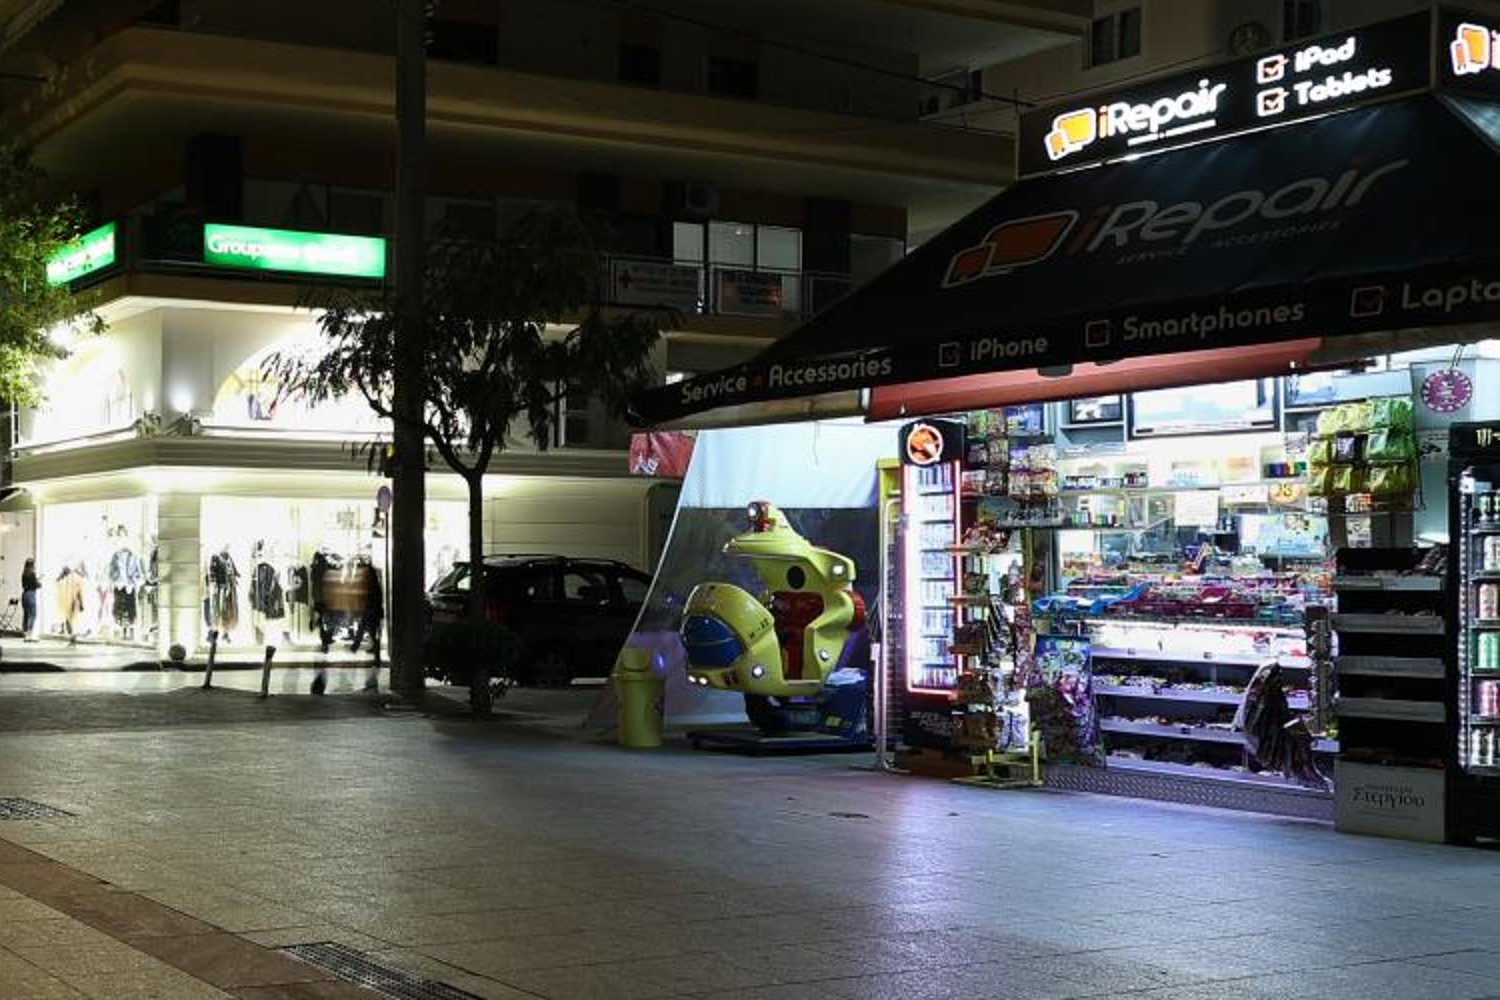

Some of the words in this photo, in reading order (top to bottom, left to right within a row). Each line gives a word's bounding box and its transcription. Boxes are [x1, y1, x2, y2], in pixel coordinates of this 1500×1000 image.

[1099, 78, 1227, 138] iRepair
[1293, 68, 1393, 105] Tablets
[1065, 153, 1411, 257] iRepair
[1123, 302, 1306, 342] Smartphones
[679, 374, 748, 405] Service
[767, 355, 894, 389] Accessories
